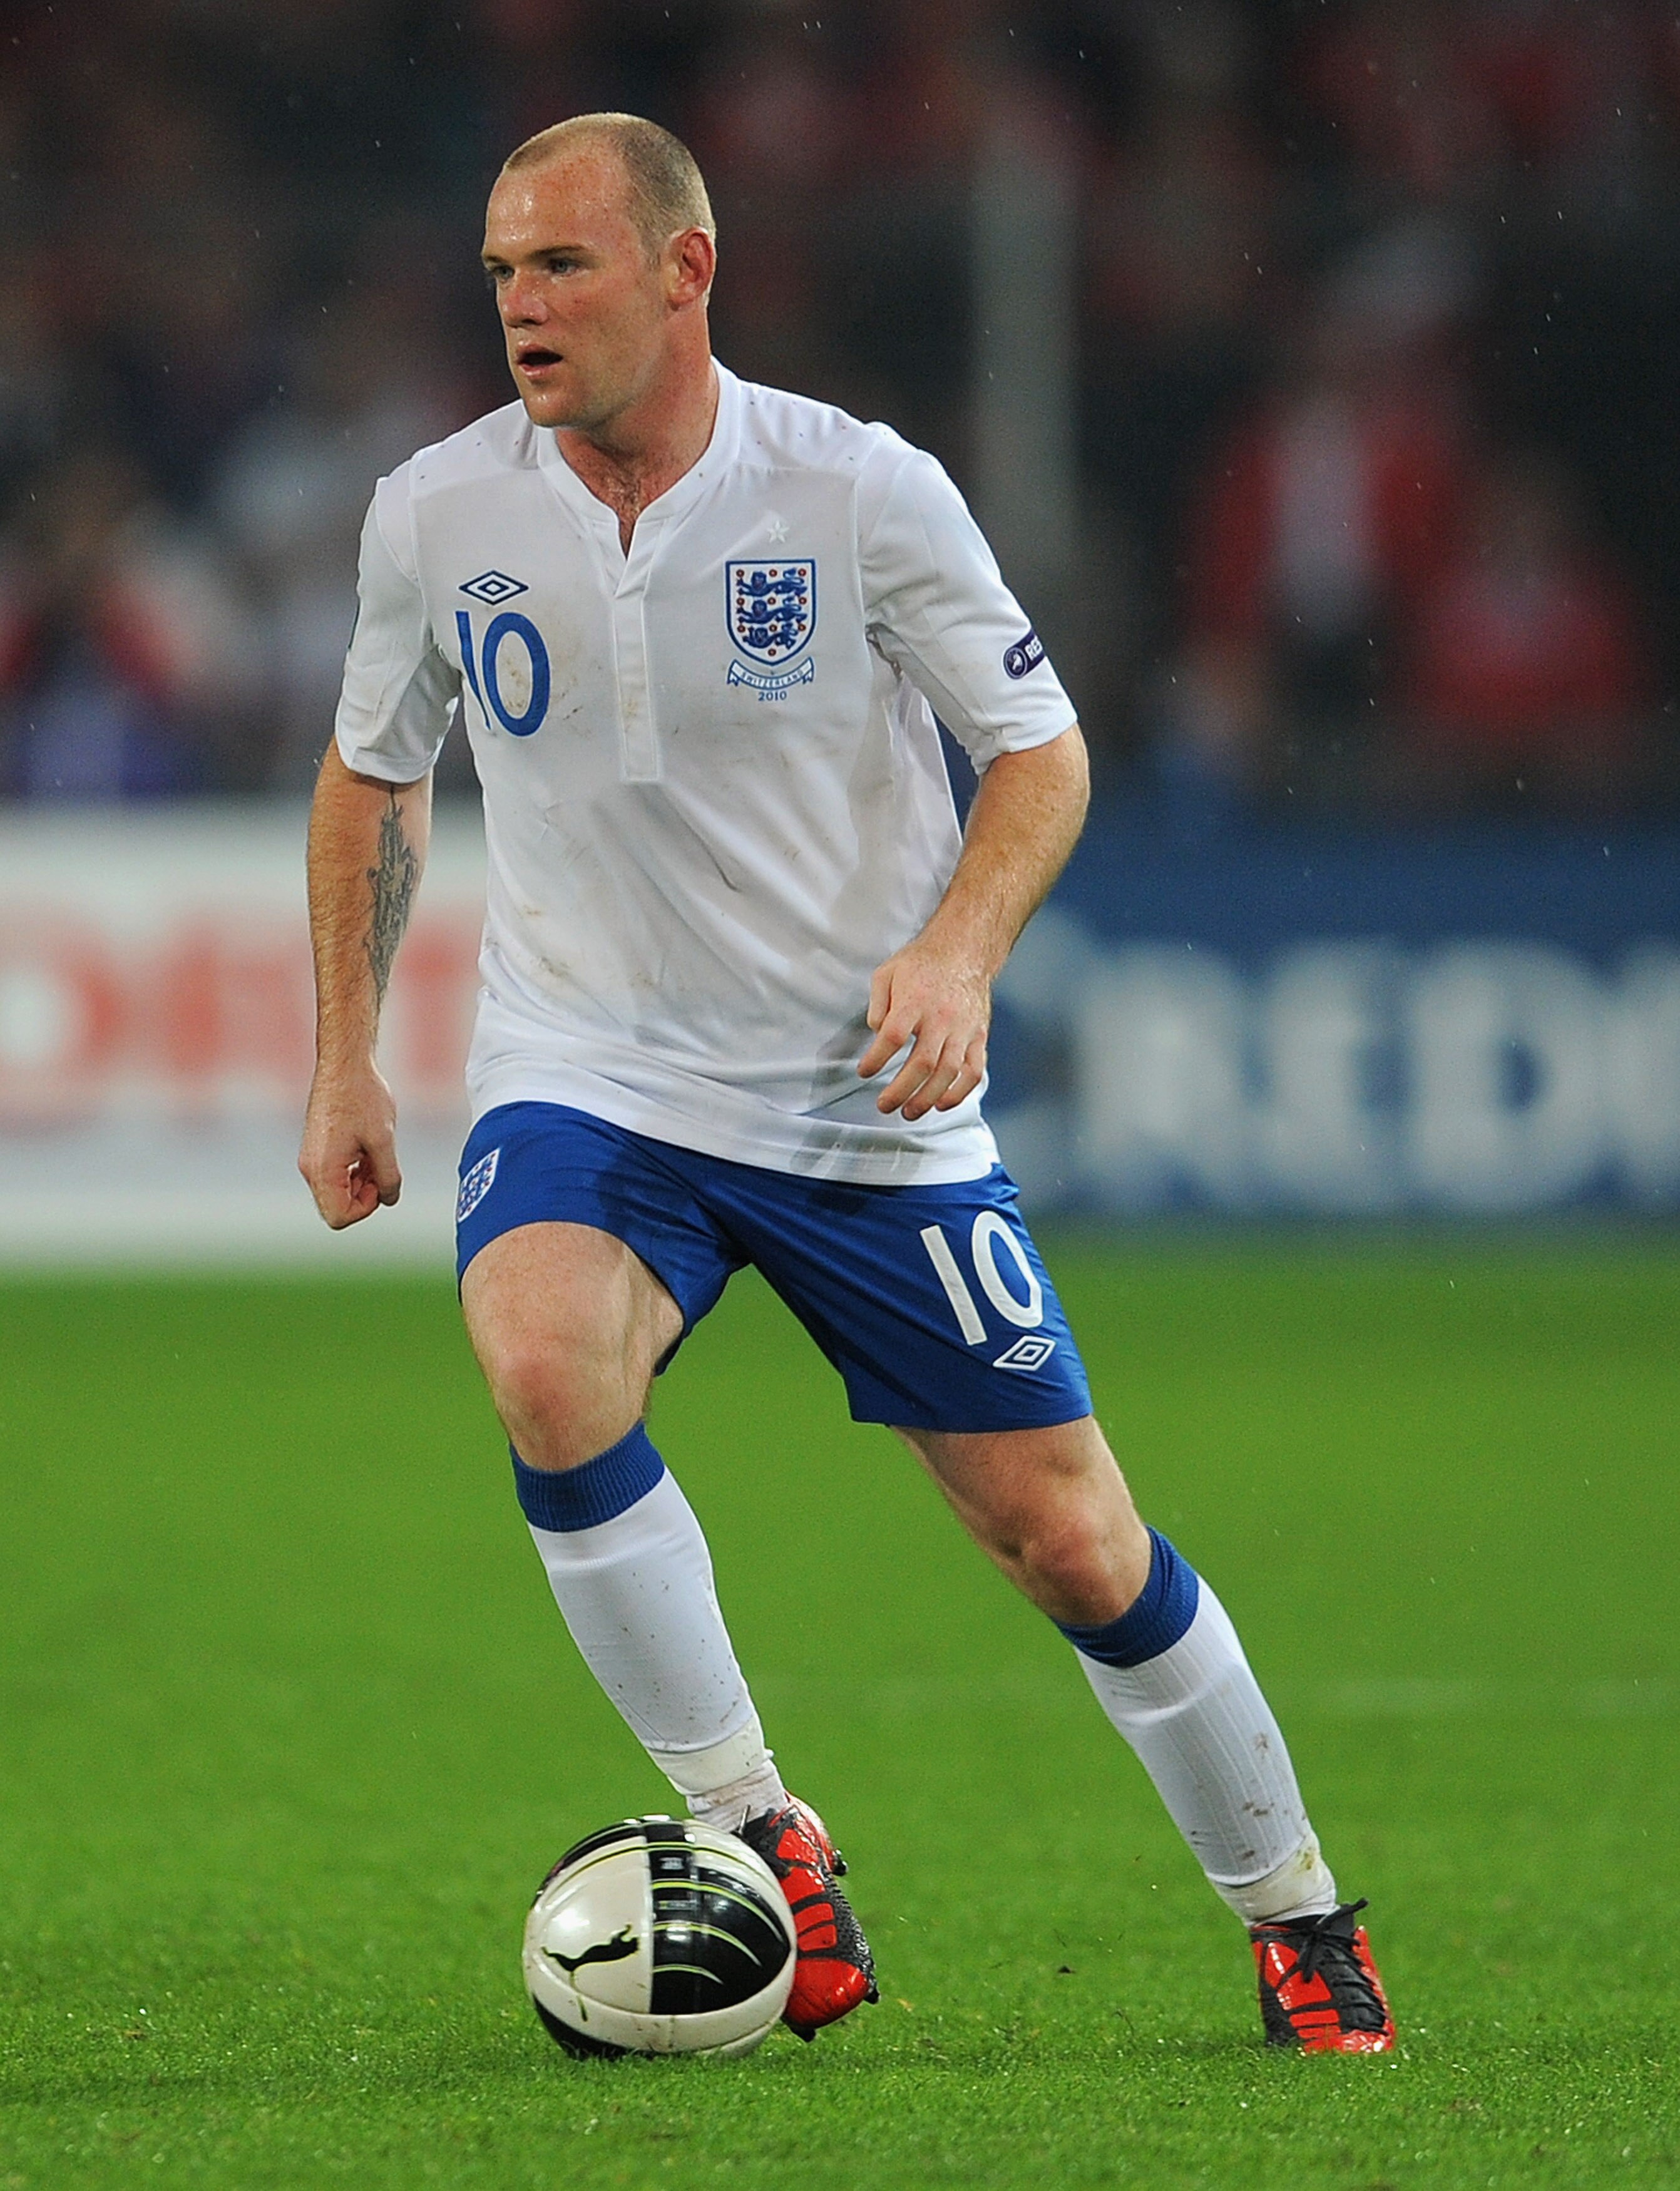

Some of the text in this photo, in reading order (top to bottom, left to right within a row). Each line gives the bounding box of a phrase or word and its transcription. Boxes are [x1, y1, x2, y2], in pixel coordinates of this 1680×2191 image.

[455, 610, 551, 737] 10
[741, 670, 804, 688] SWITZERLAND
[758, 690, 787, 702] 2010
[919, 1210, 1043, 1346] 10
